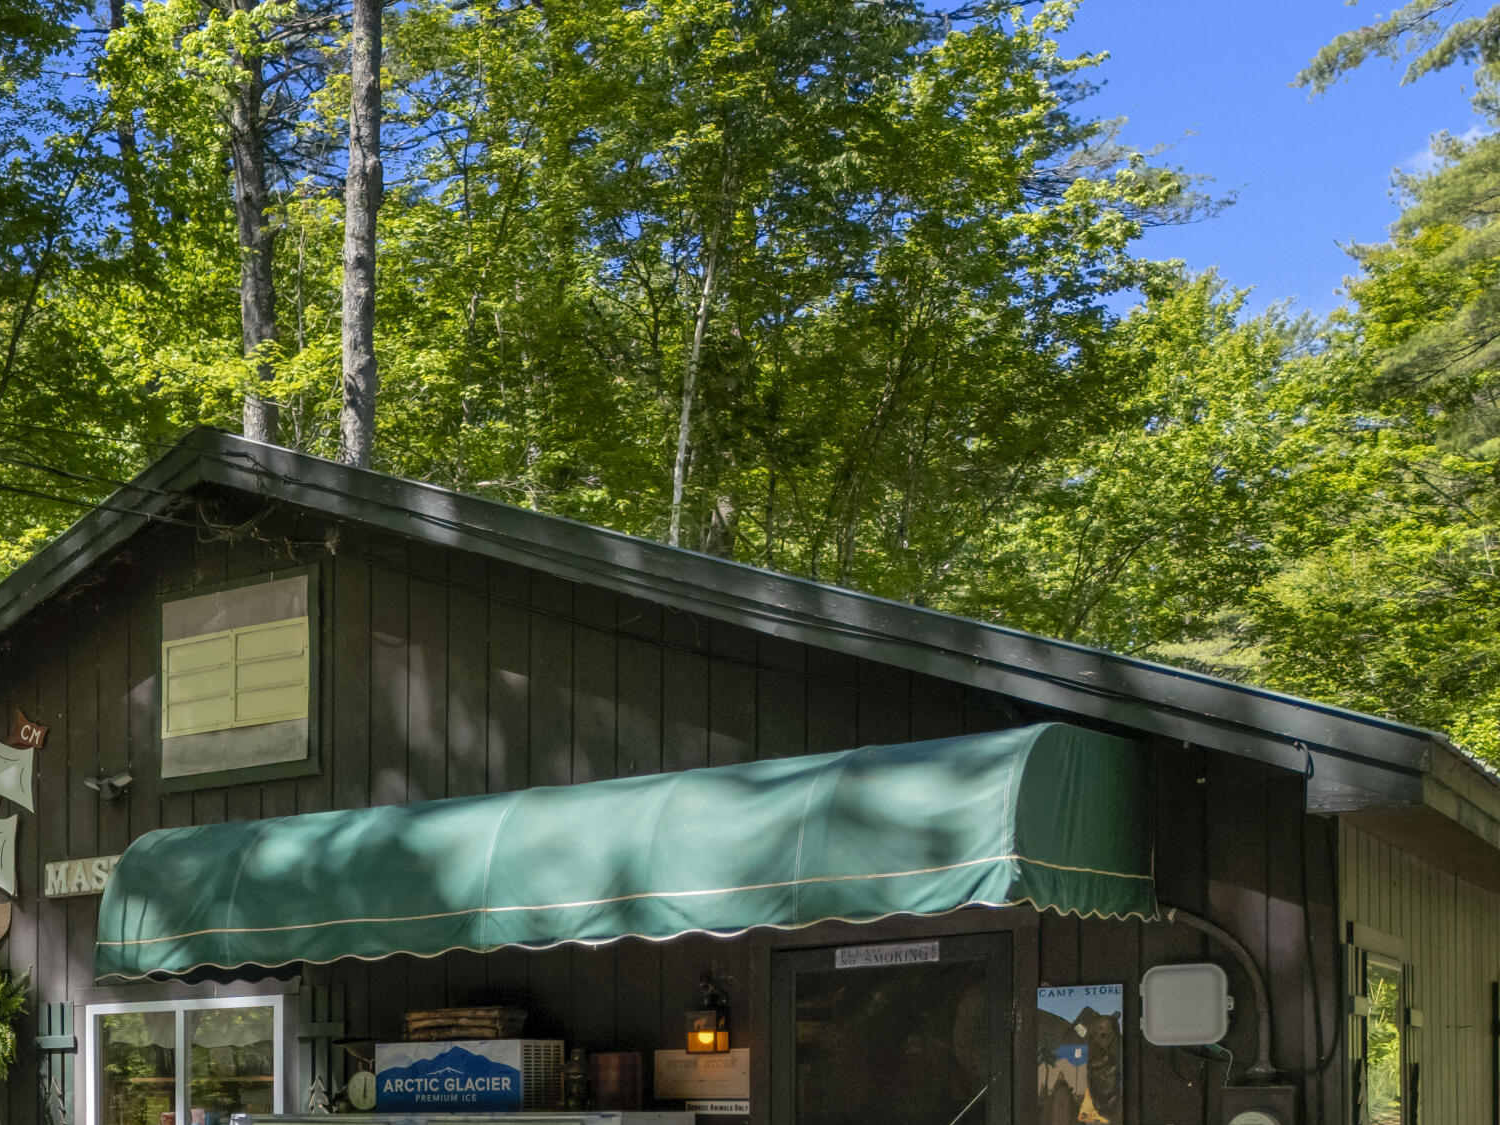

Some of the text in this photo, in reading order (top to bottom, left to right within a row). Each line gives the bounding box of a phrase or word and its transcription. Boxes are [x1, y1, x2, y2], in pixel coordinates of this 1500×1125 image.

[21, 725, 41, 744] CM
[1039, 986, 1122, 998] CAMP STORE
[383, 1076, 511, 1093] ARCTIC GLACIER
[415, 1093, 477, 1103] PREMIUM ICE
